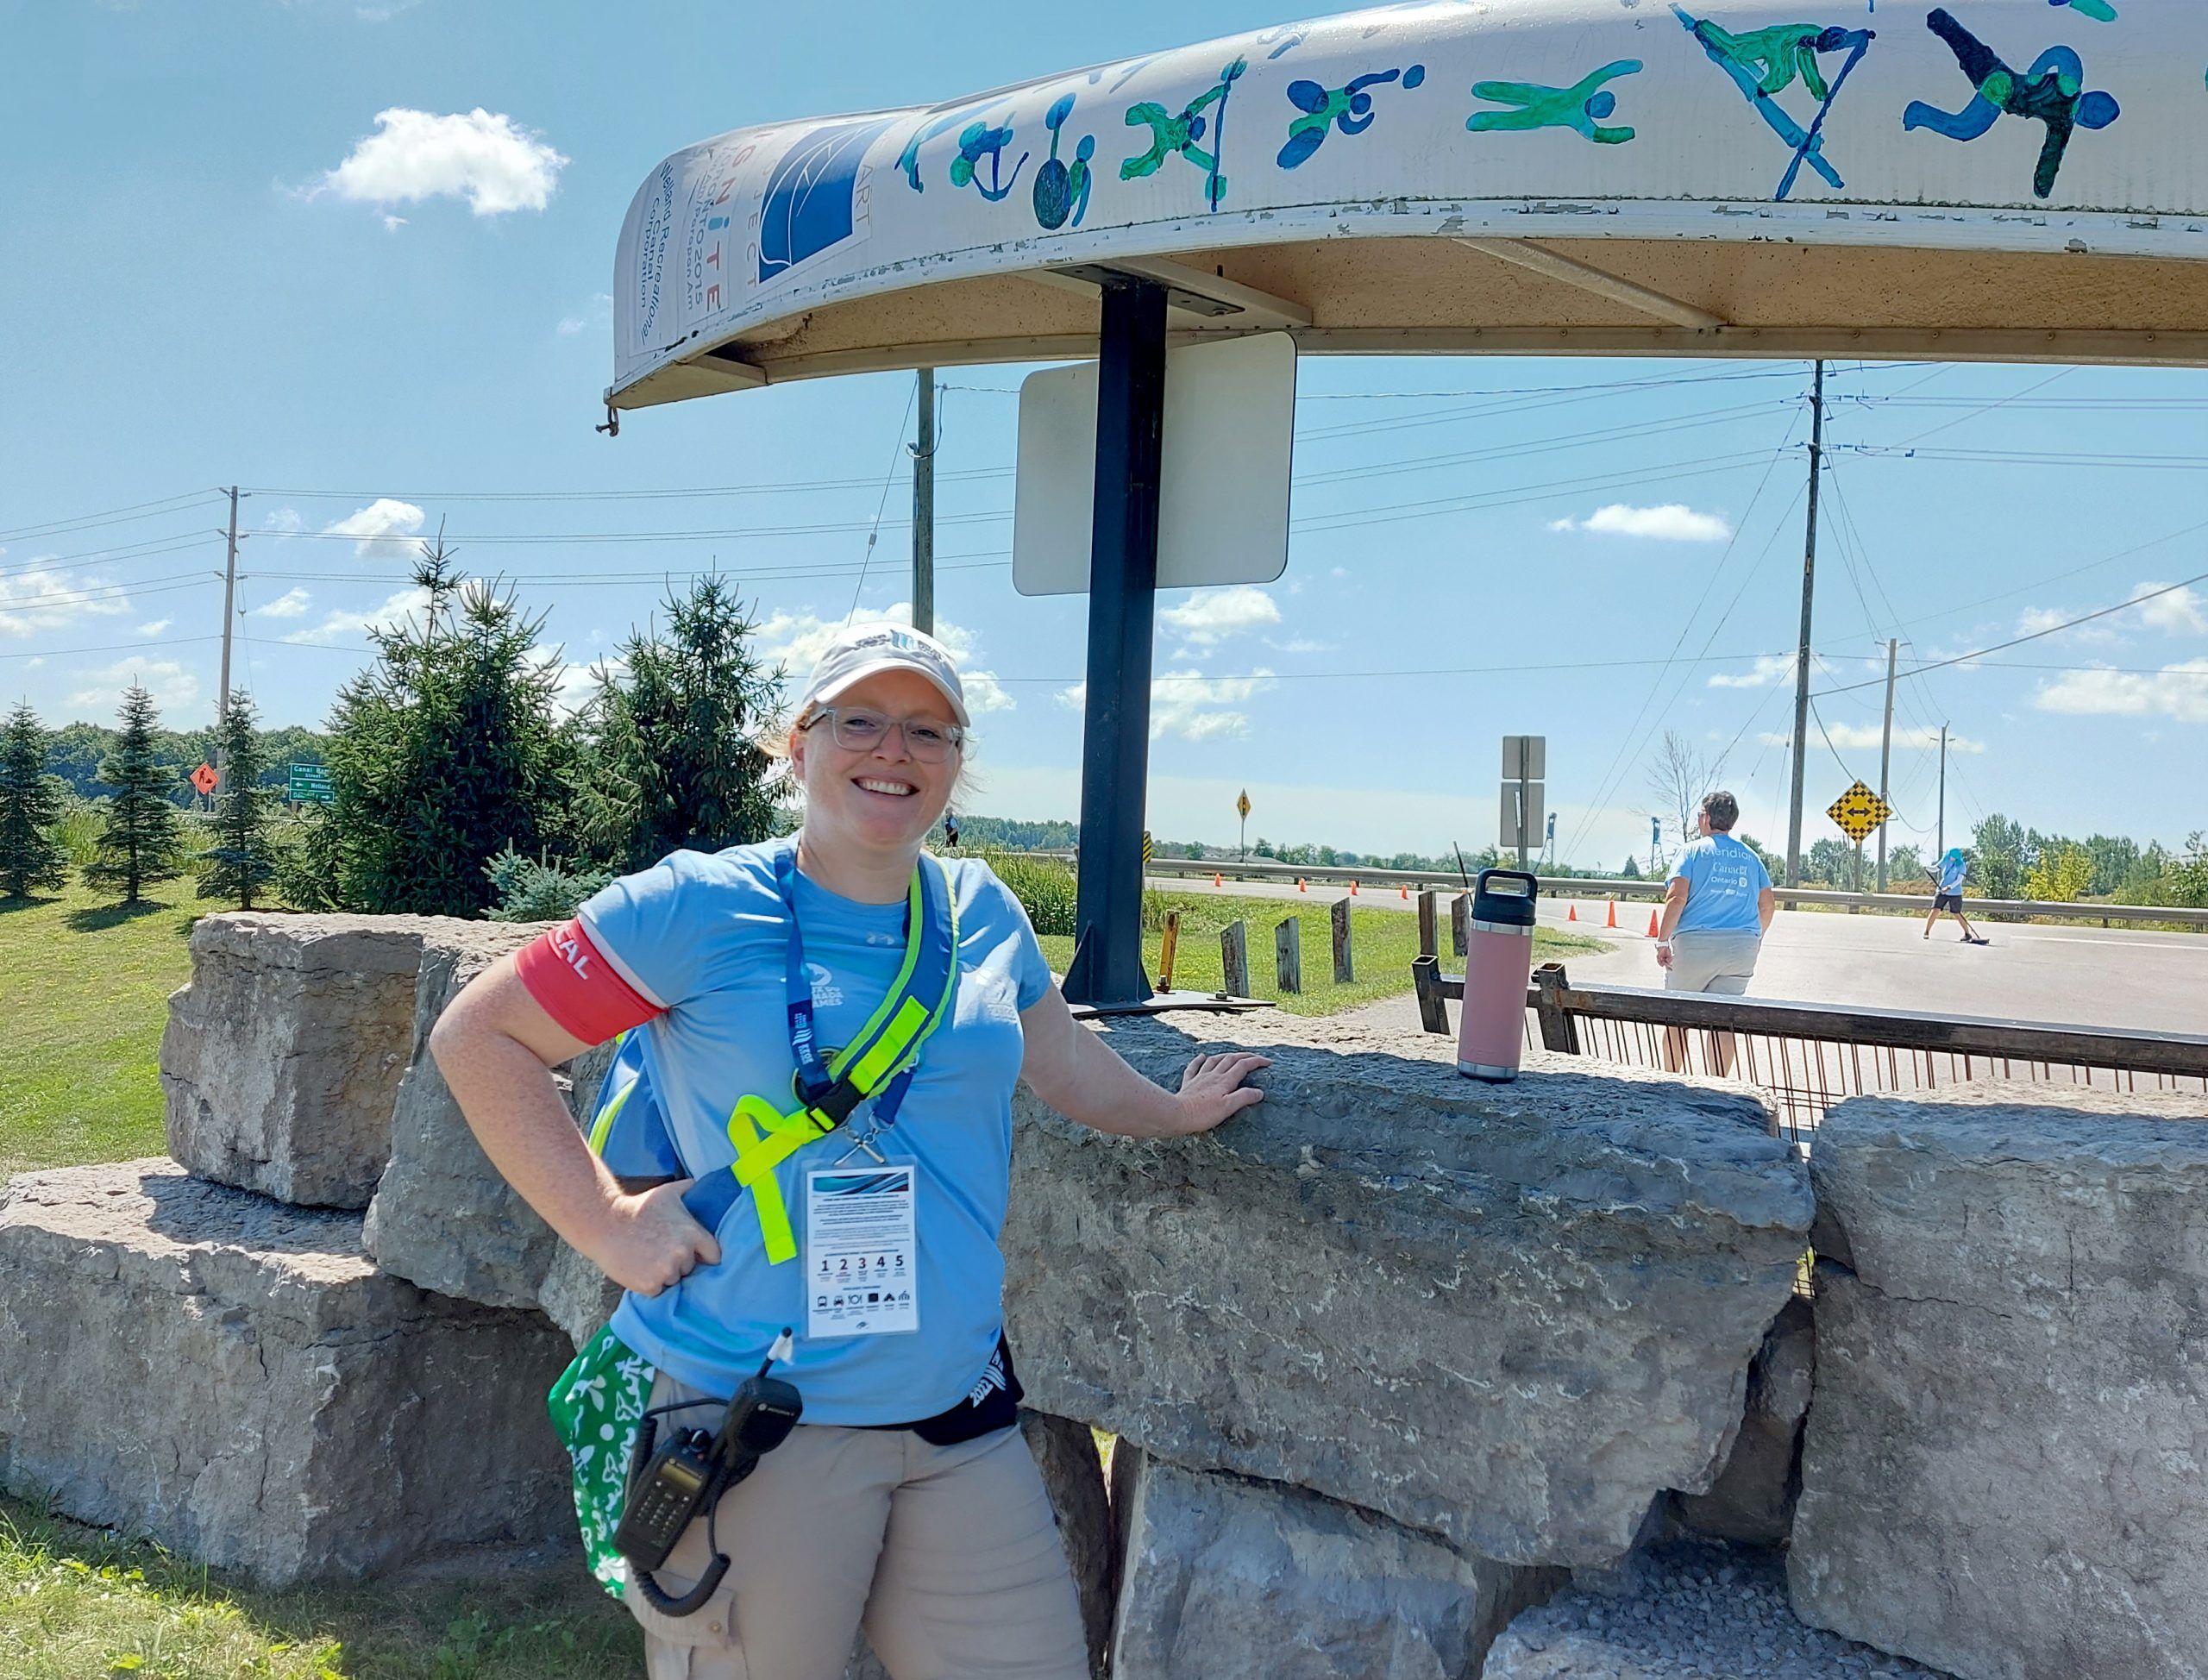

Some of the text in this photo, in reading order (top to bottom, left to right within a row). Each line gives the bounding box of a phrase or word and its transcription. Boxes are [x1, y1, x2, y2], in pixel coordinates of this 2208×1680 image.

[854, 164, 874, 227] ART
[640, 197, 660, 309] Corporation
[641, 161, 672, 345] Welland Recreational
[647, 219, 662, 280] Canal
[1700, 848, 1753, 862] Meridian
[1711, 876, 1737, 885] Ontario
[821, 1255, 903, 1271] 1 2 3 4 5
